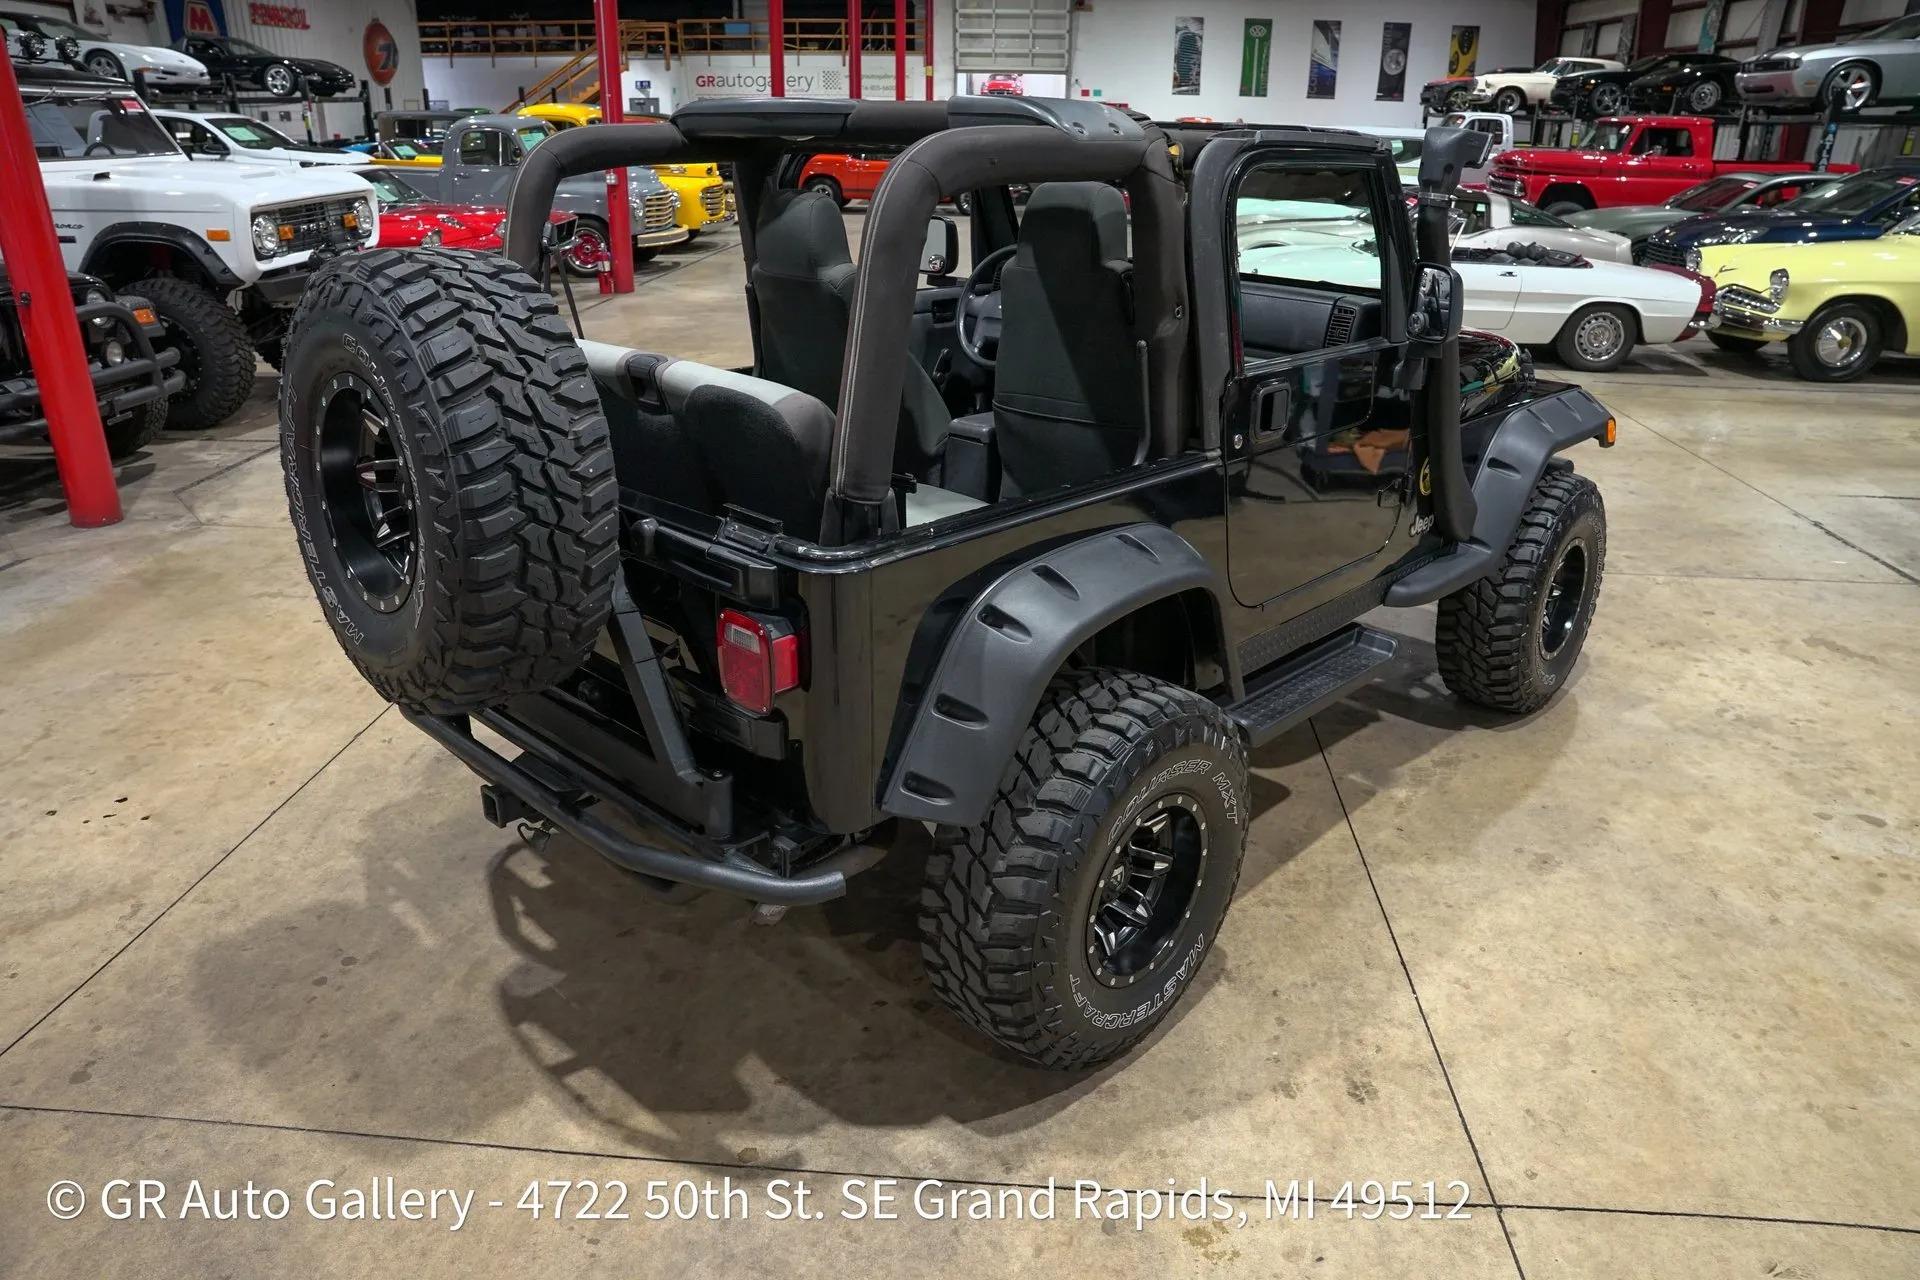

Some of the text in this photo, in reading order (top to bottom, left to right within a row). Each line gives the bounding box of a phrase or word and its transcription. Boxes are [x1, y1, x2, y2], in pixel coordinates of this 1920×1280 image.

[695, 73, 814, 92] GRautogery
[285, 373, 365, 646] MASTERCRAFT
[1409, 513, 1435, 537] Jeep
[1211, 771, 1239, 825] MXT
[1068, 932, 1205, 1030] MASTERCRAFT
